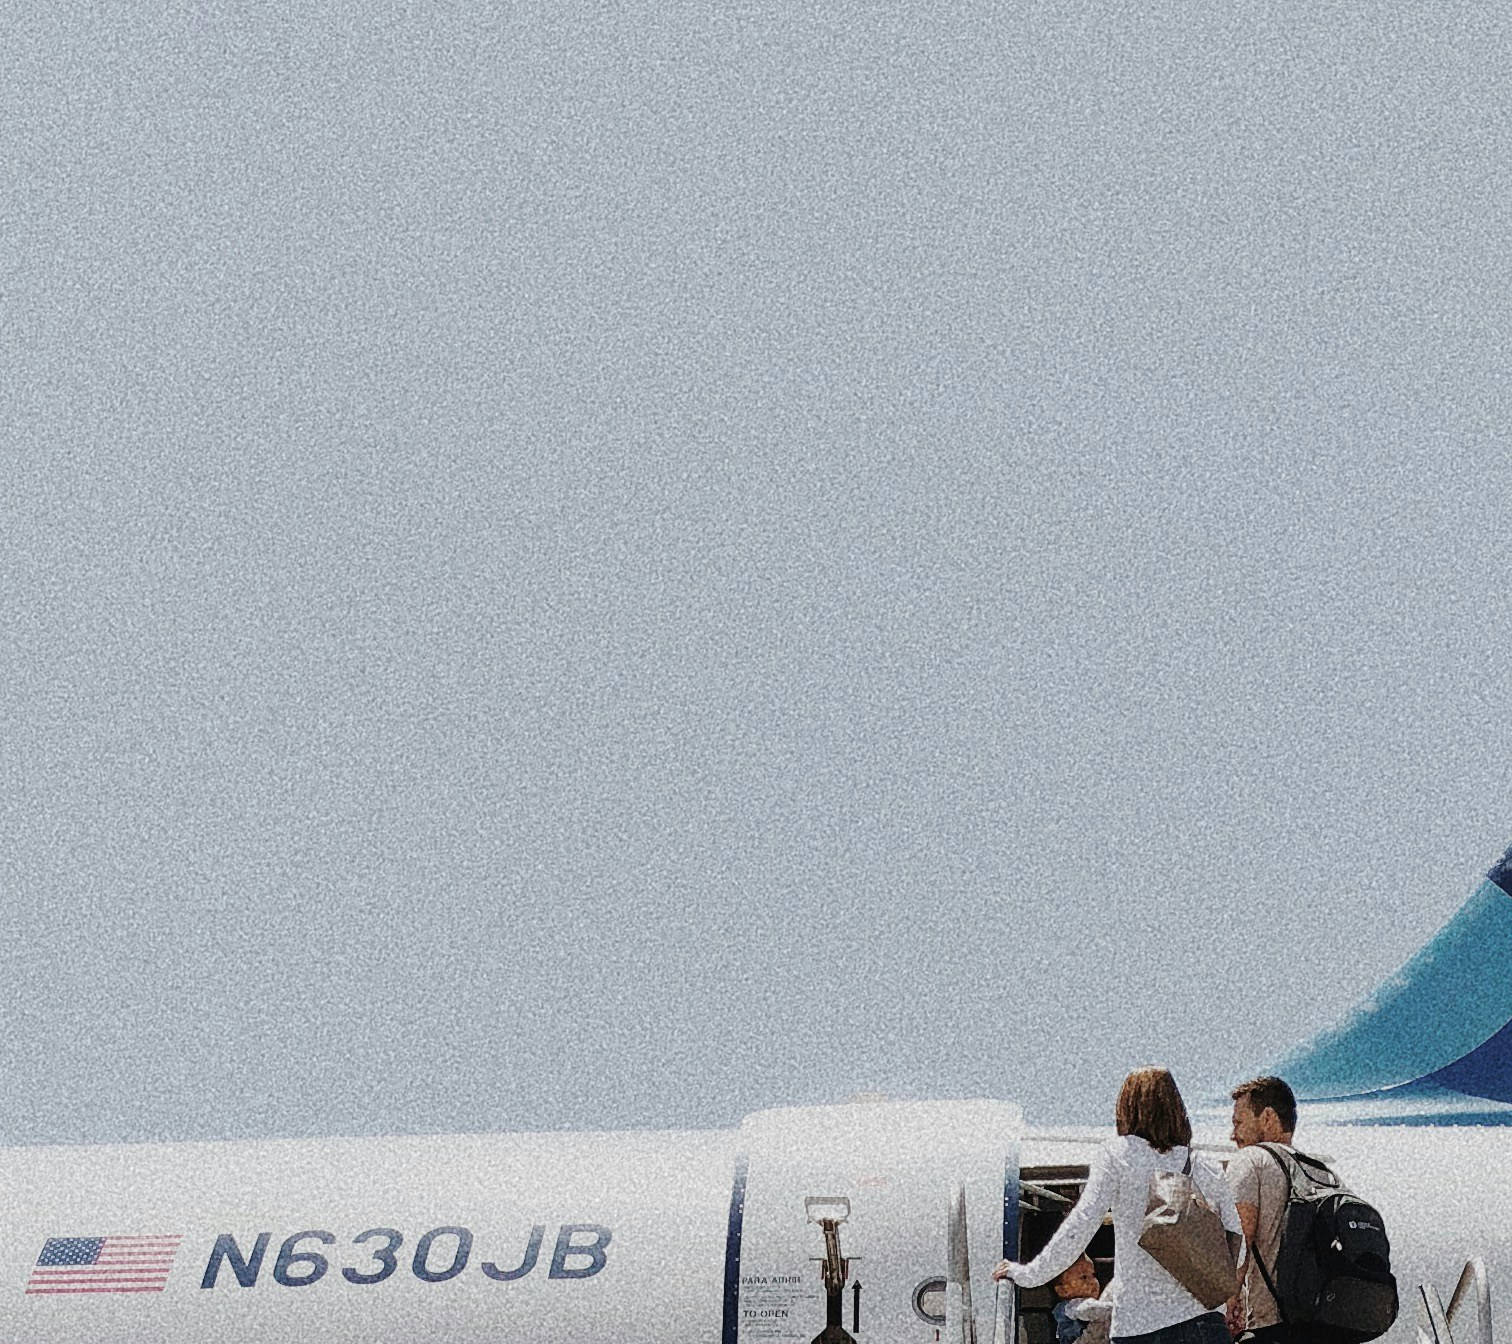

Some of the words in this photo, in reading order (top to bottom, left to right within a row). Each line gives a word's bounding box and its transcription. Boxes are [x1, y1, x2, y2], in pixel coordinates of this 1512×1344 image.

[200, 1223, 613, 1290] N630JB
[743, 1309, 757, 1318] TO
[760, 1309, 789, 1319] OPEN
